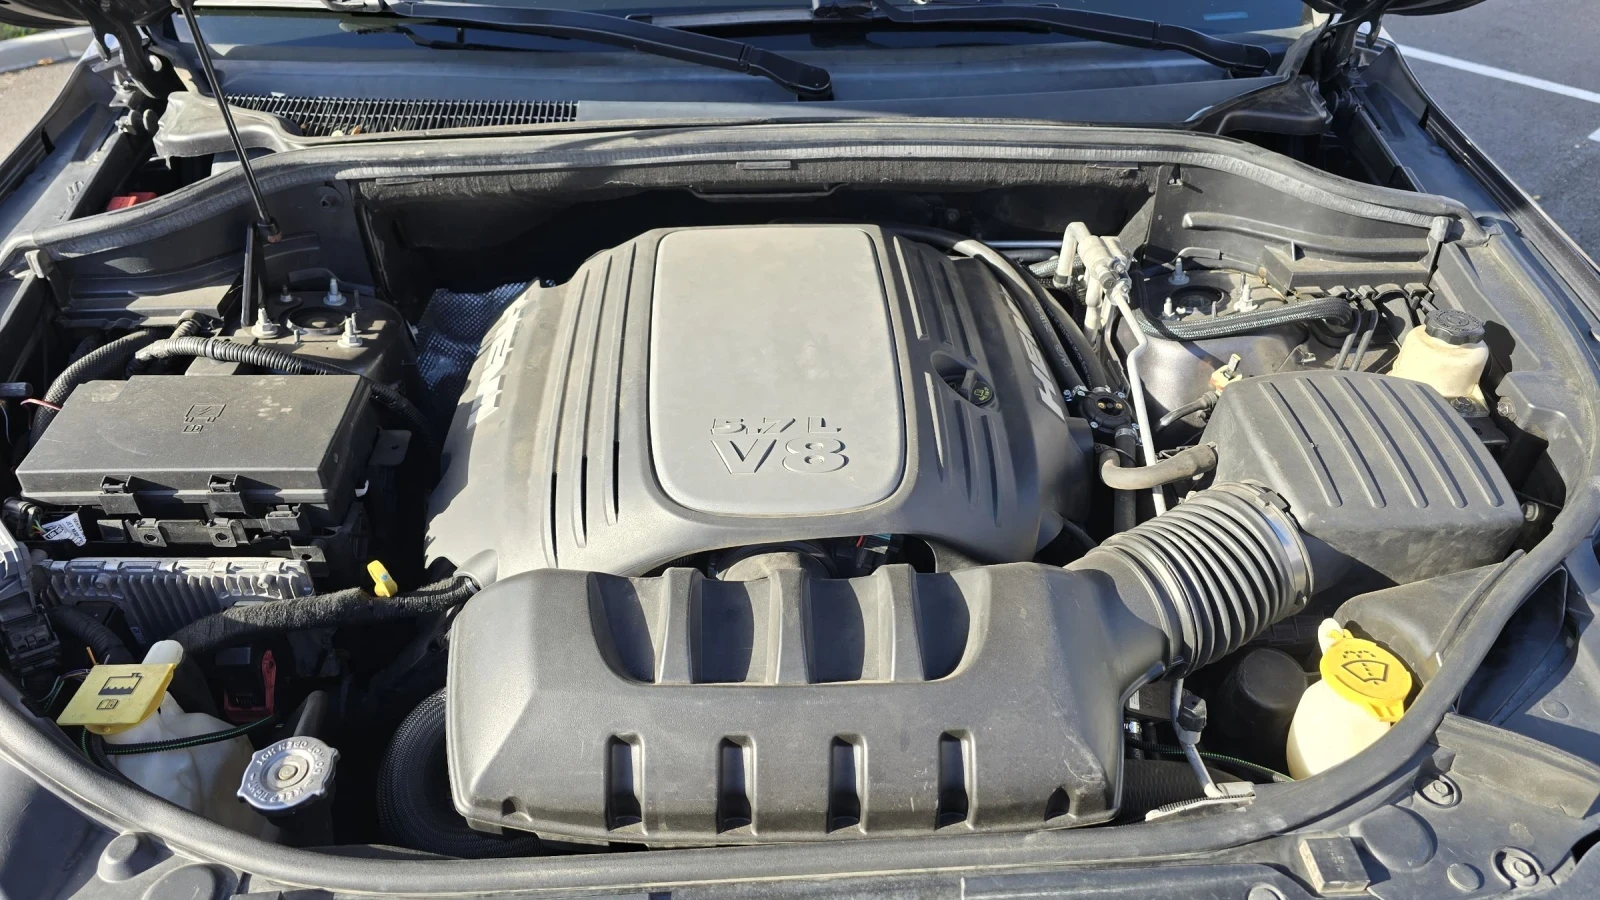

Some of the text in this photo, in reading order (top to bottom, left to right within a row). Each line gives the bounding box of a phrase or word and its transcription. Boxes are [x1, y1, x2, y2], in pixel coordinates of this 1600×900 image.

[1000, 282, 1065, 421] HEMI
[709, 436, 851, 475] V8
[279, 740, 308, 752] OPEN
[256, 747, 276, 766] HOT
[247, 781, 269, 801] TIGHT
